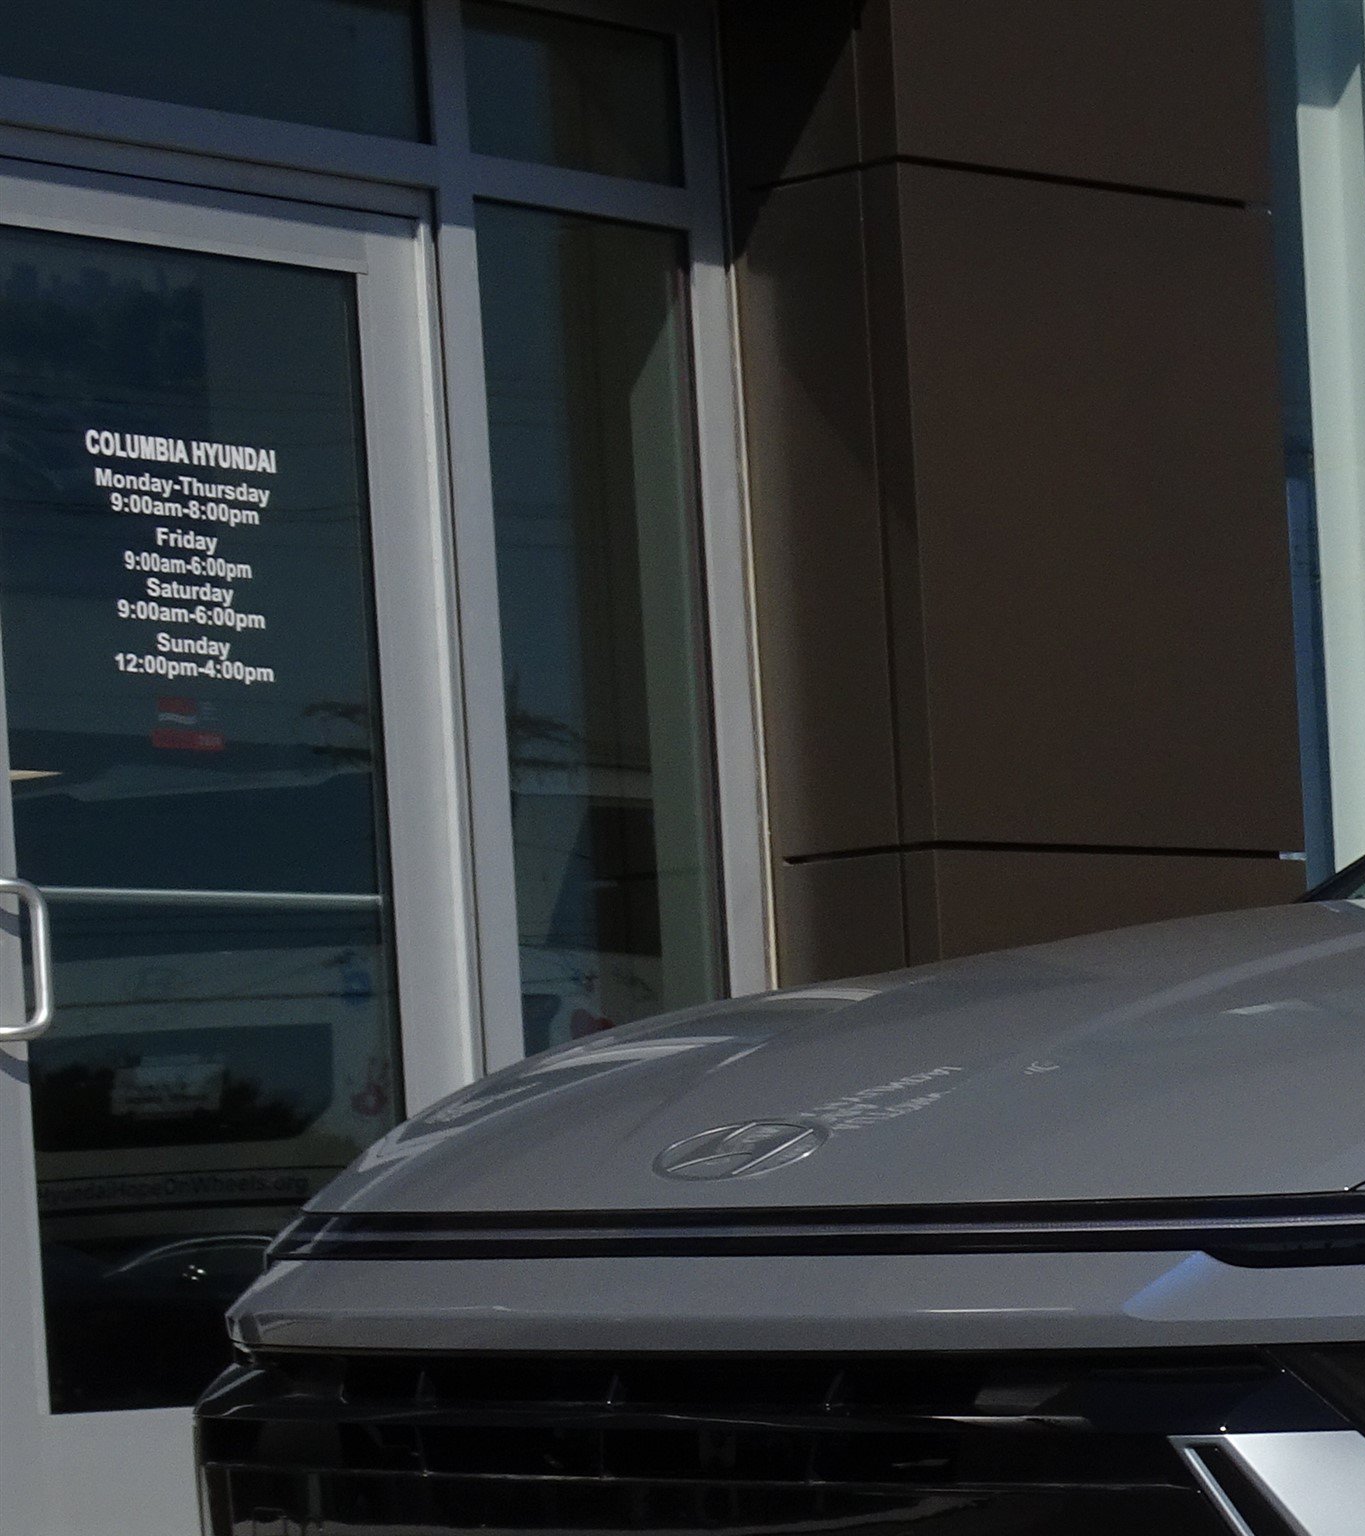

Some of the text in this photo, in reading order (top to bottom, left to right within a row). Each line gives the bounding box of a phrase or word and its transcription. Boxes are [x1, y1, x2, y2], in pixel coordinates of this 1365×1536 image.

[85, 429, 277, 474] COLUMBIA HYUNDAI
[94, 467, 270, 508] Monday-Thursday
[110, 493, 260, 527] 9:00am-8:00pm
[155, 527, 217, 555] Friday
[124, 550, 252, 581] 9:00am-6:00pm
[146, 577, 234, 607] Saturday
[117, 599, 266, 632] 9:00am-6:00pm
[156, 632, 231, 661] Sunday
[115, 652, 275, 685] 12:00pm-4:00pm
